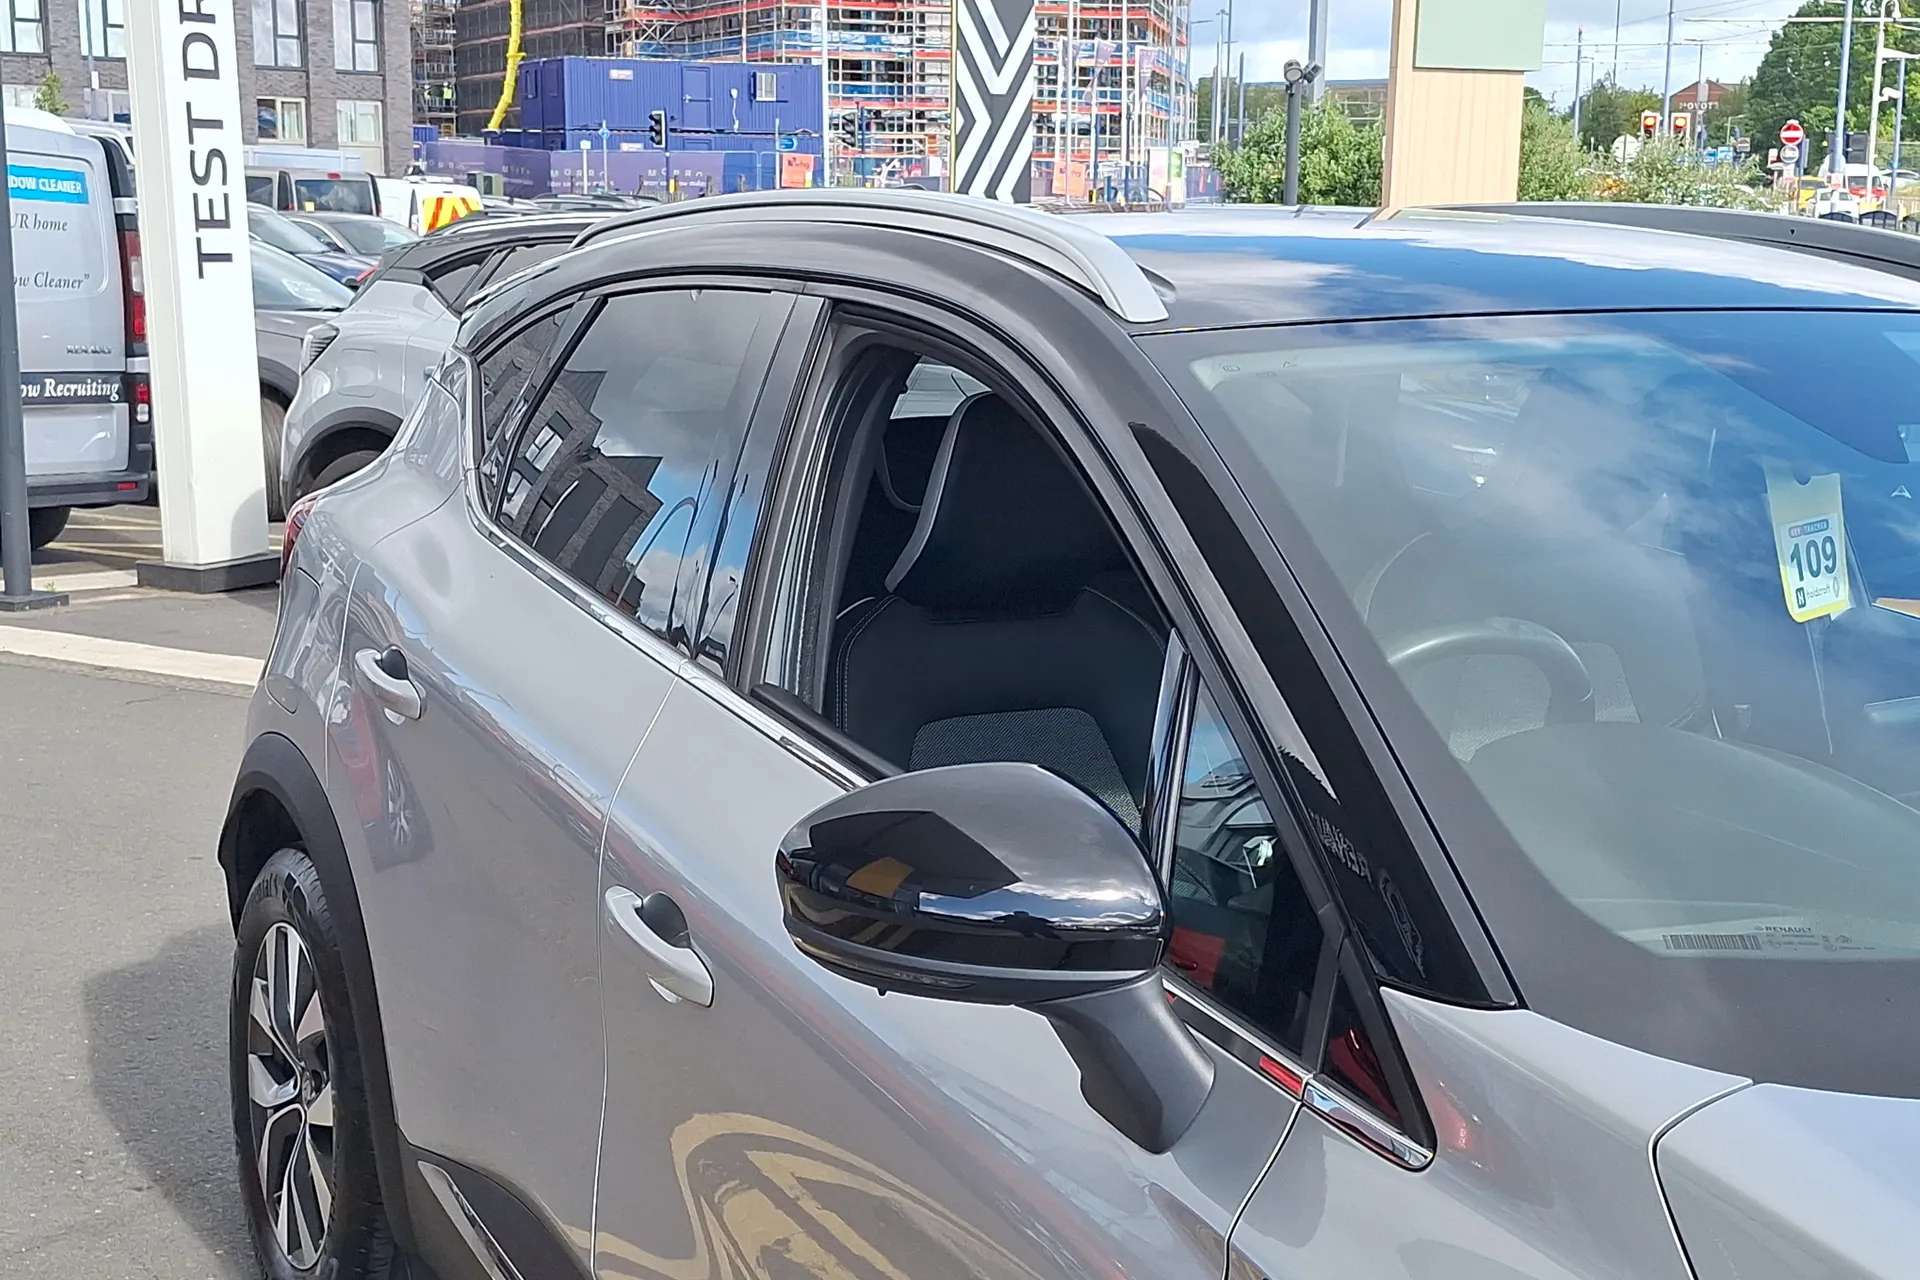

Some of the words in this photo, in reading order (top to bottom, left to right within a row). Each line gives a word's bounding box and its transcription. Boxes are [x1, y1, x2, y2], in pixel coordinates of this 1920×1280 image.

[39, 179, 82, 194] CLEANER
[186, 101, 233, 279] TEST
[33, 213, 68, 231] home
[44, 378, 119, 402] Recruiting
[1791, 536, 1837, 582] 109
